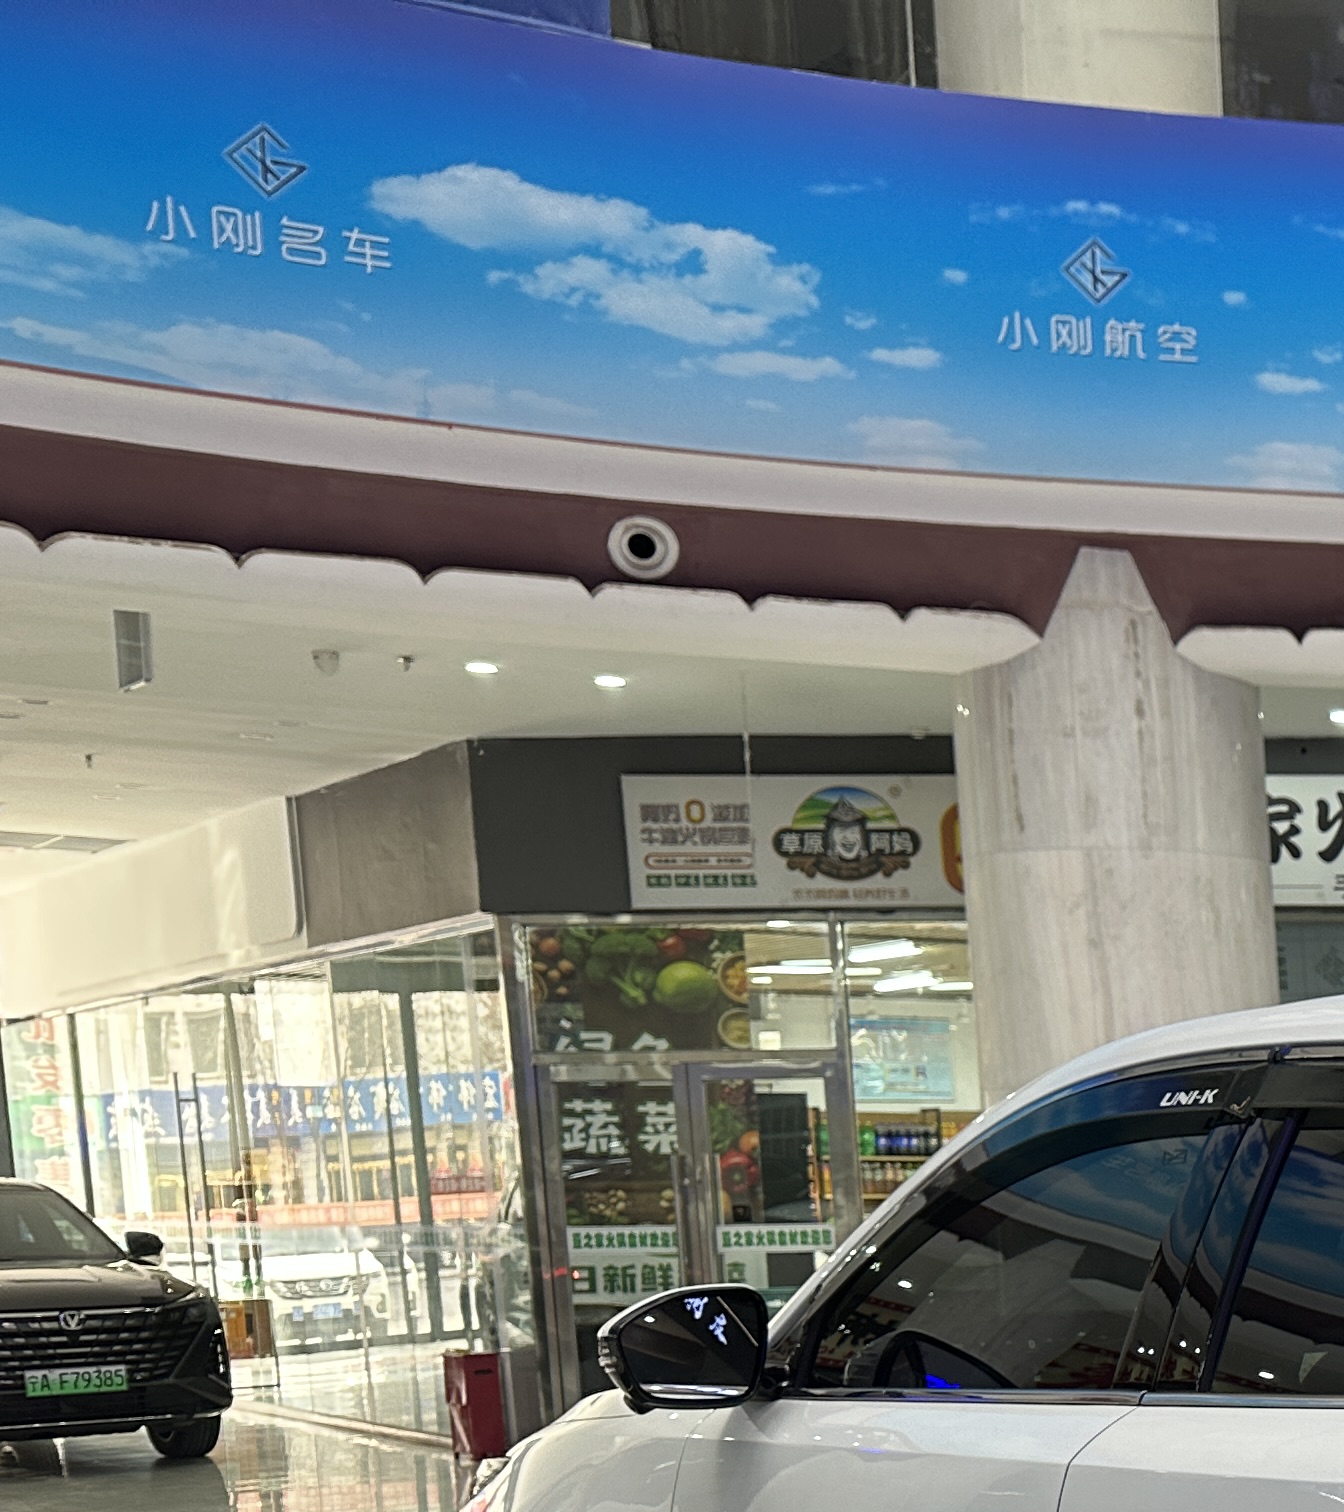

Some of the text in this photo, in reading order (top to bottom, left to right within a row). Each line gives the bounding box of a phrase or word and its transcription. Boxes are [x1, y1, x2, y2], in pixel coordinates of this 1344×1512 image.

[145, 195, 392, 274] 小刚名车
[997, 311, 1199, 364] 小刚航空
[1159, 1088, 1220, 1107] UNI-K
[561, 1098, 679, 1155] 蔬菜
